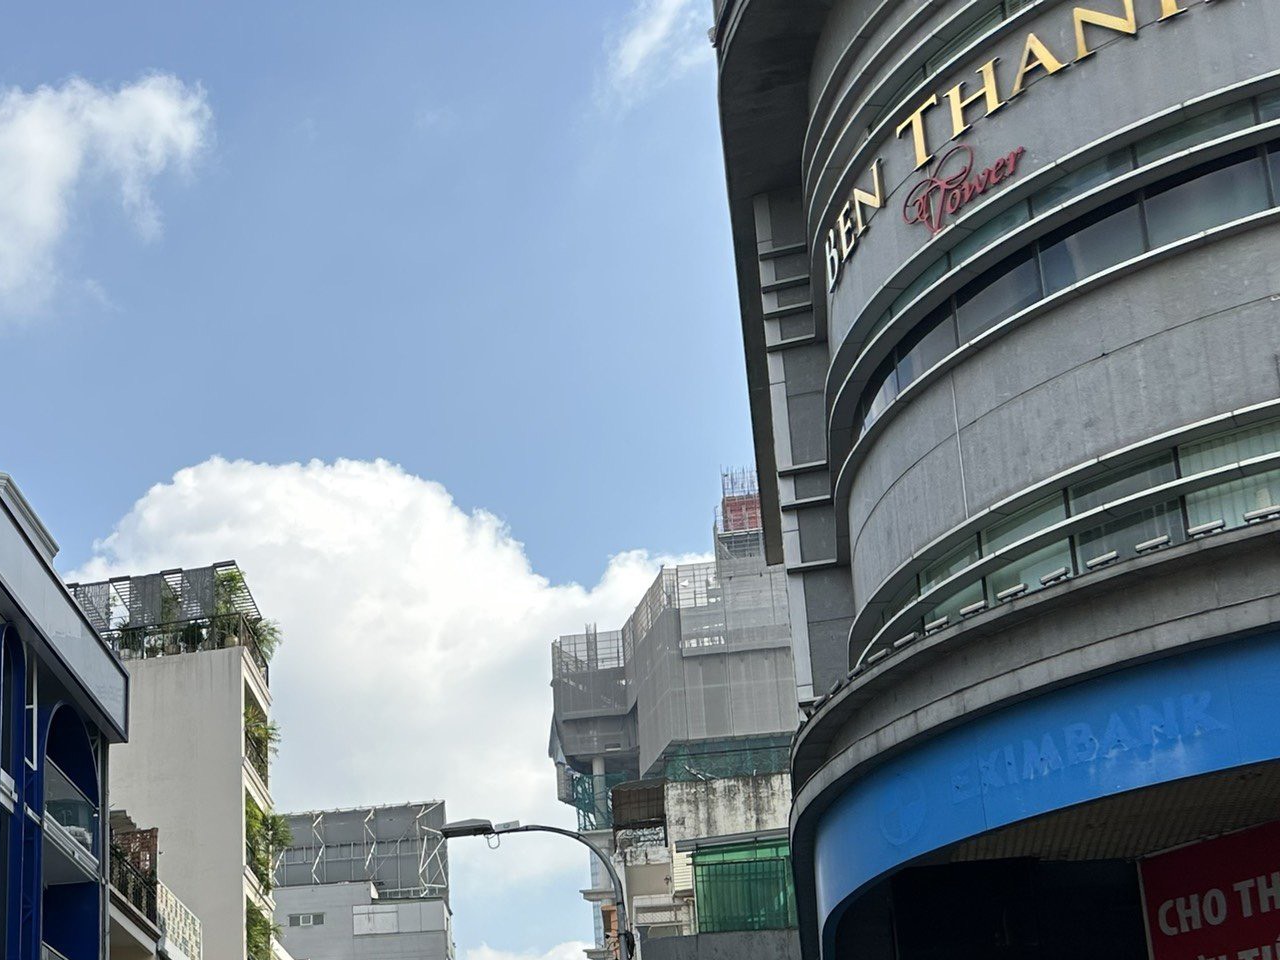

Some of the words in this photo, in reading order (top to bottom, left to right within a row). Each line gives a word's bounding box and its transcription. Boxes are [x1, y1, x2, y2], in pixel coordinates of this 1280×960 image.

[824, 157, 886, 294] BEN
[896, 0, 1220, 171] THAN
[903, 144, 1026, 238] Tower
[1158, 888, 1227, 936] CHO
